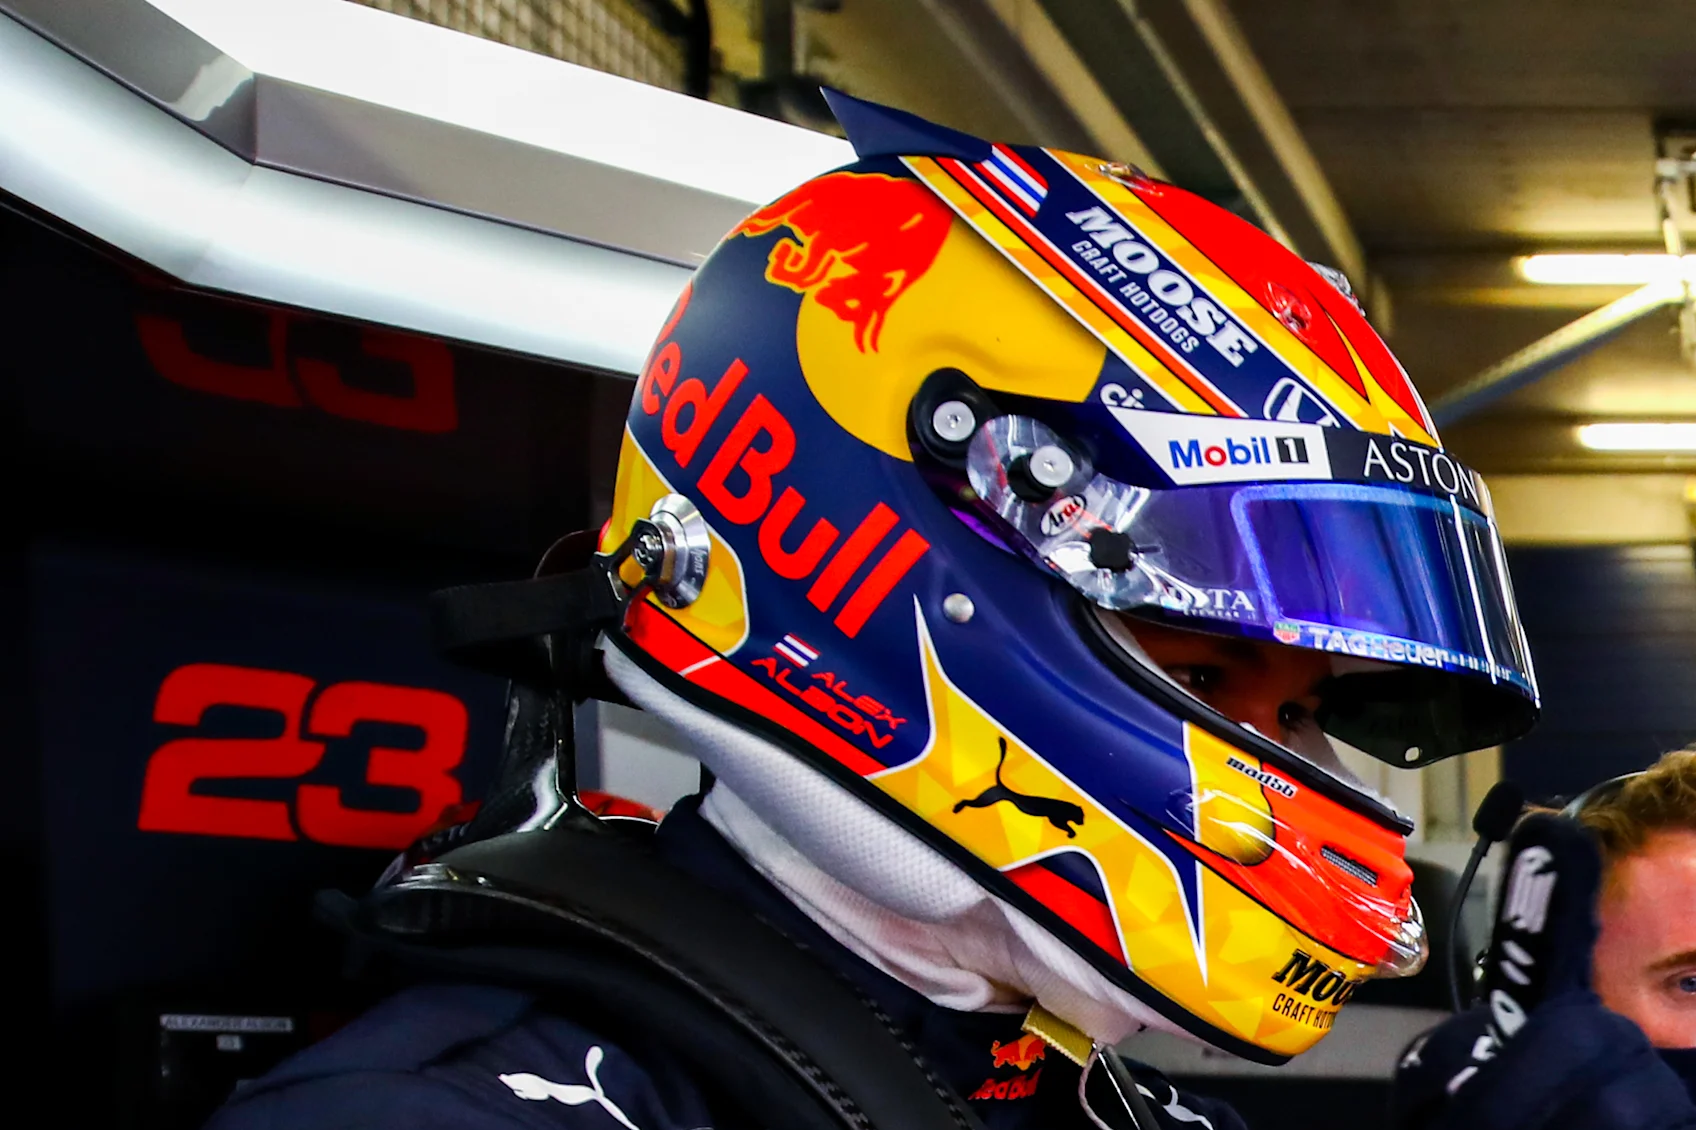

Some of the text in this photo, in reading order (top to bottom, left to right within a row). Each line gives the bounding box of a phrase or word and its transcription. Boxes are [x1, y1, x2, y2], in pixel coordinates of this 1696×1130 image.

[1065, 206, 1258, 368] MOOSE
[1071, 240, 1200, 353] CRAFT HOTDOGS
[1168, 436, 1307, 470] Mobil 1
[1363, 438, 1481, 505] ASTON
[696, 394, 931, 639] Bull
[751, 657, 894, 749] ALBON
[810, 671, 907, 729] ALEX
[137, 663, 469, 850] 23
[1272, 949, 1356, 1006] MOO
[1272, 993, 1315, 1027] CRAFT
